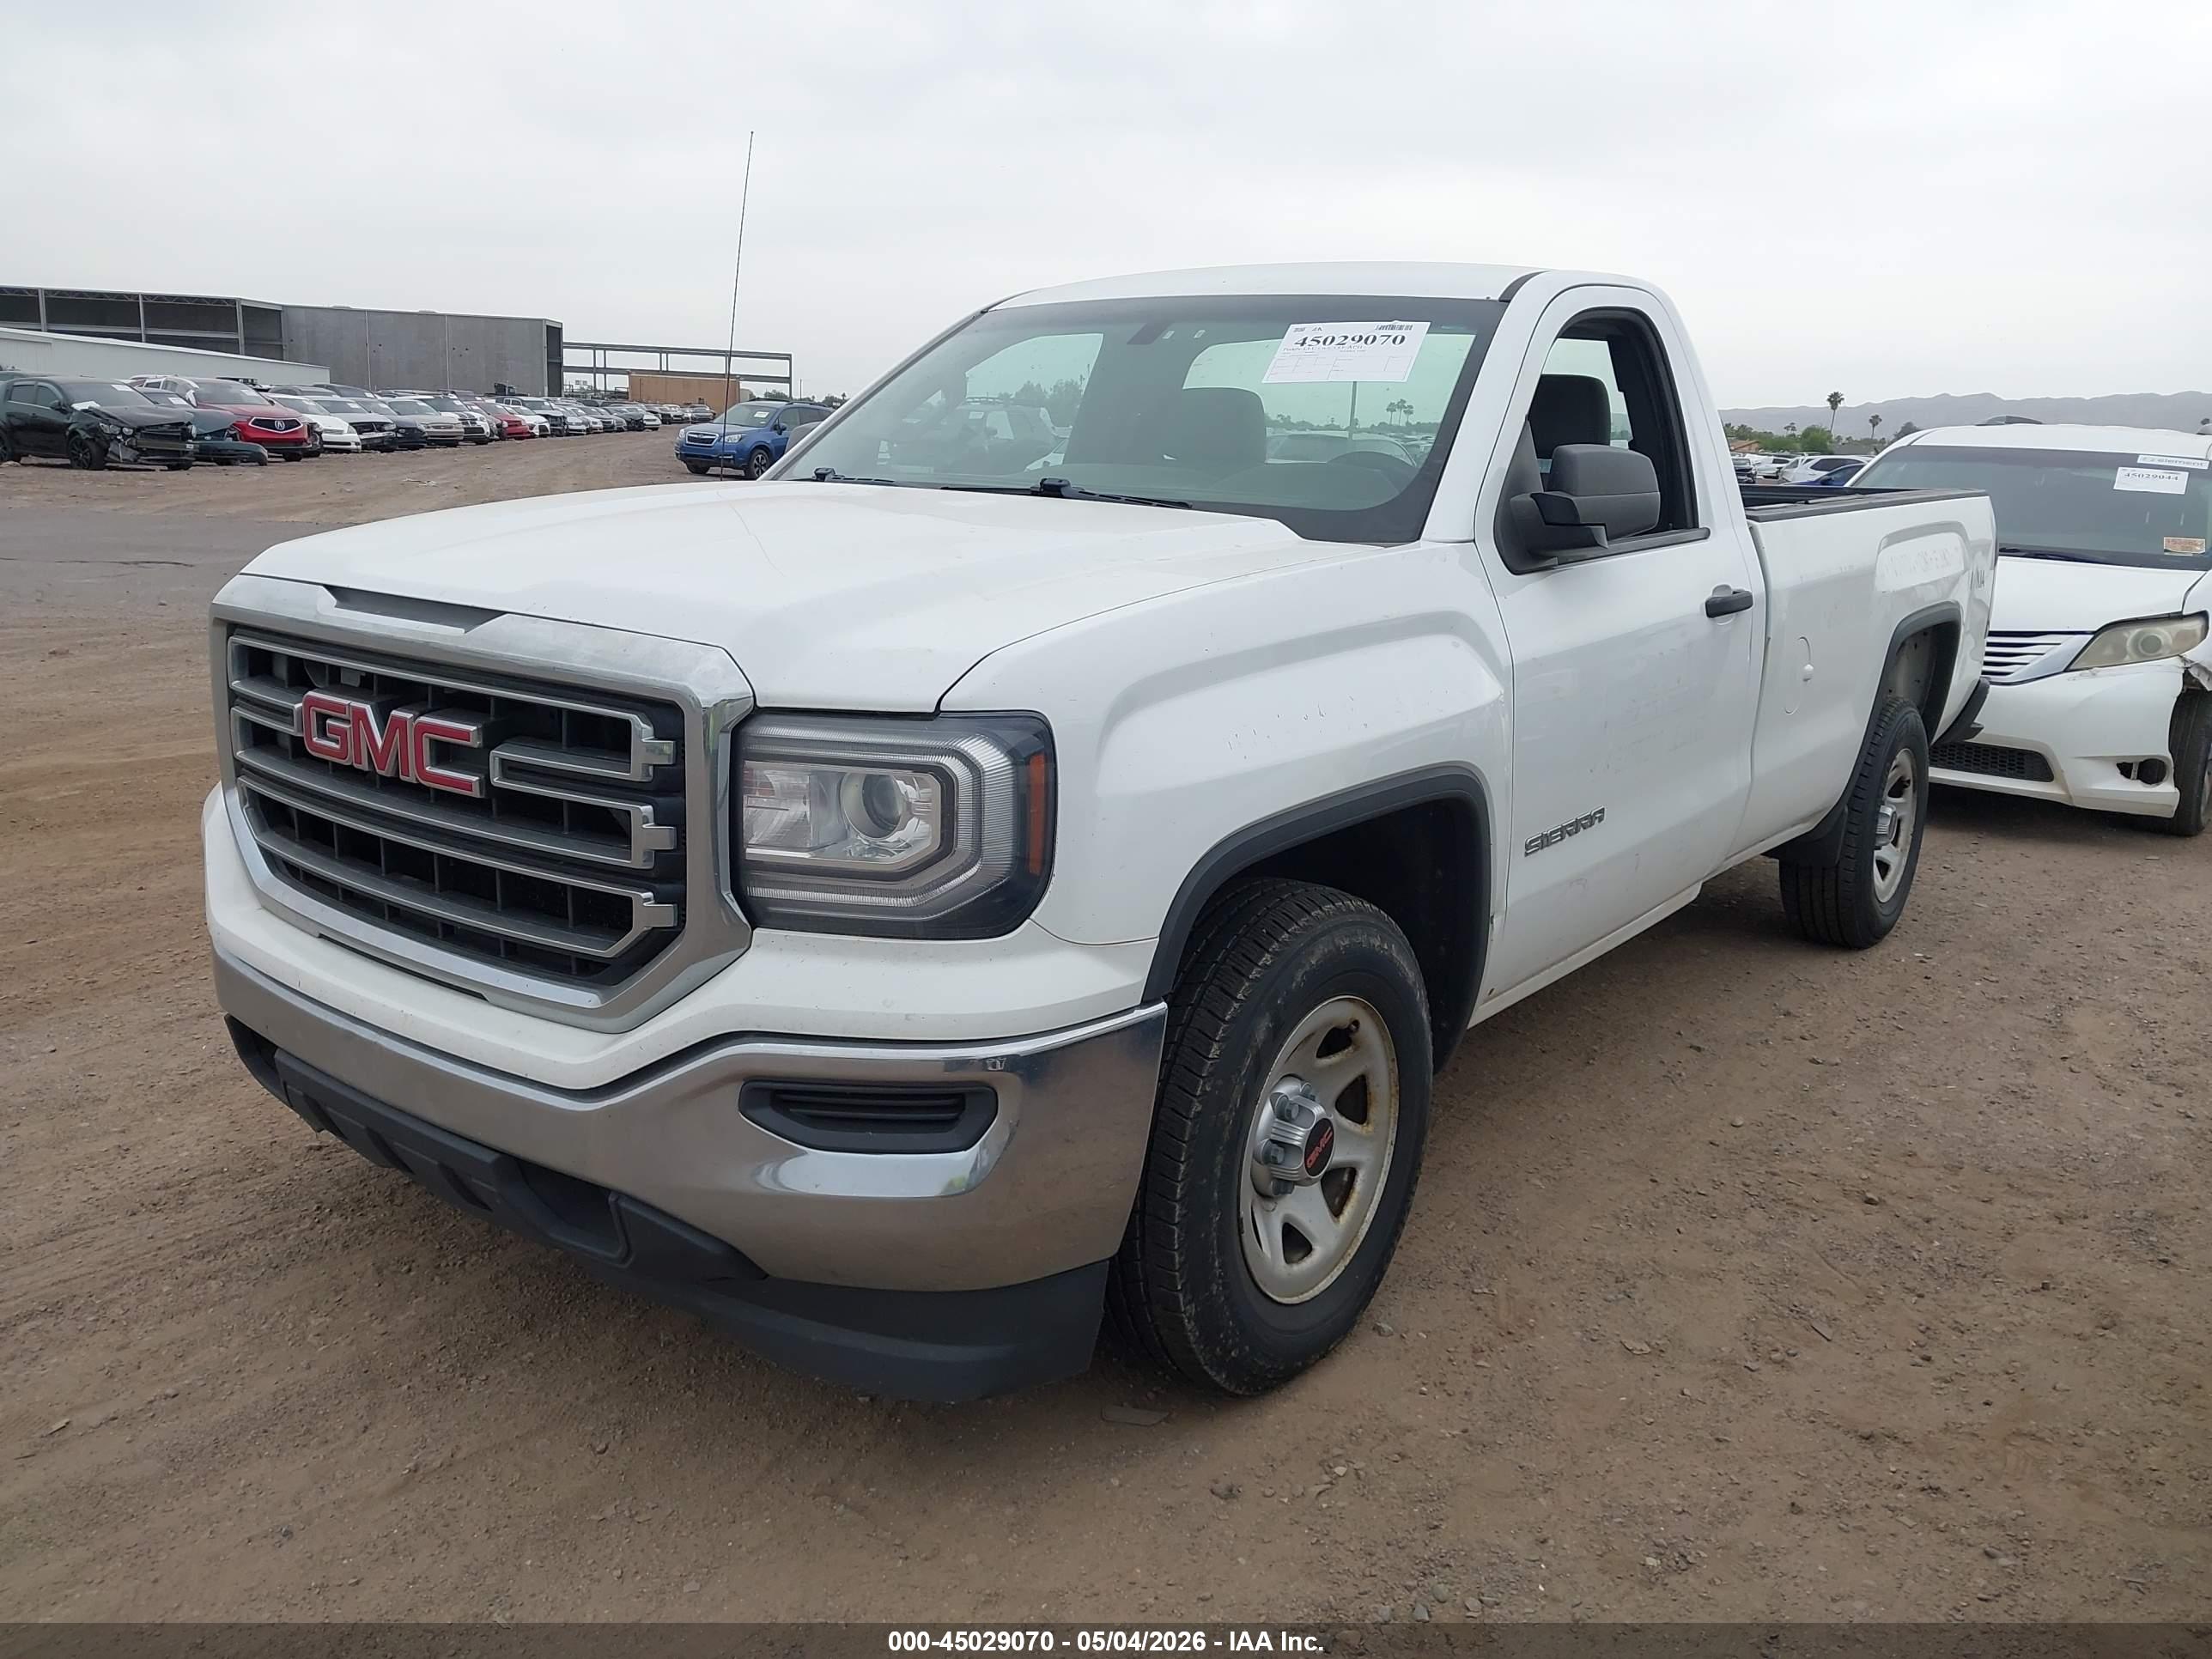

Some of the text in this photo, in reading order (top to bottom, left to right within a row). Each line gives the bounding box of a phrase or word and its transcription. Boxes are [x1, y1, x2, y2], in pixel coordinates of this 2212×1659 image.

[1293, 334, 1406, 347] 45029070
[302, 691, 484, 799] GMC
[1524, 805, 1606, 857] SIERRA
[1305, 1126, 1334, 1169] GMC
